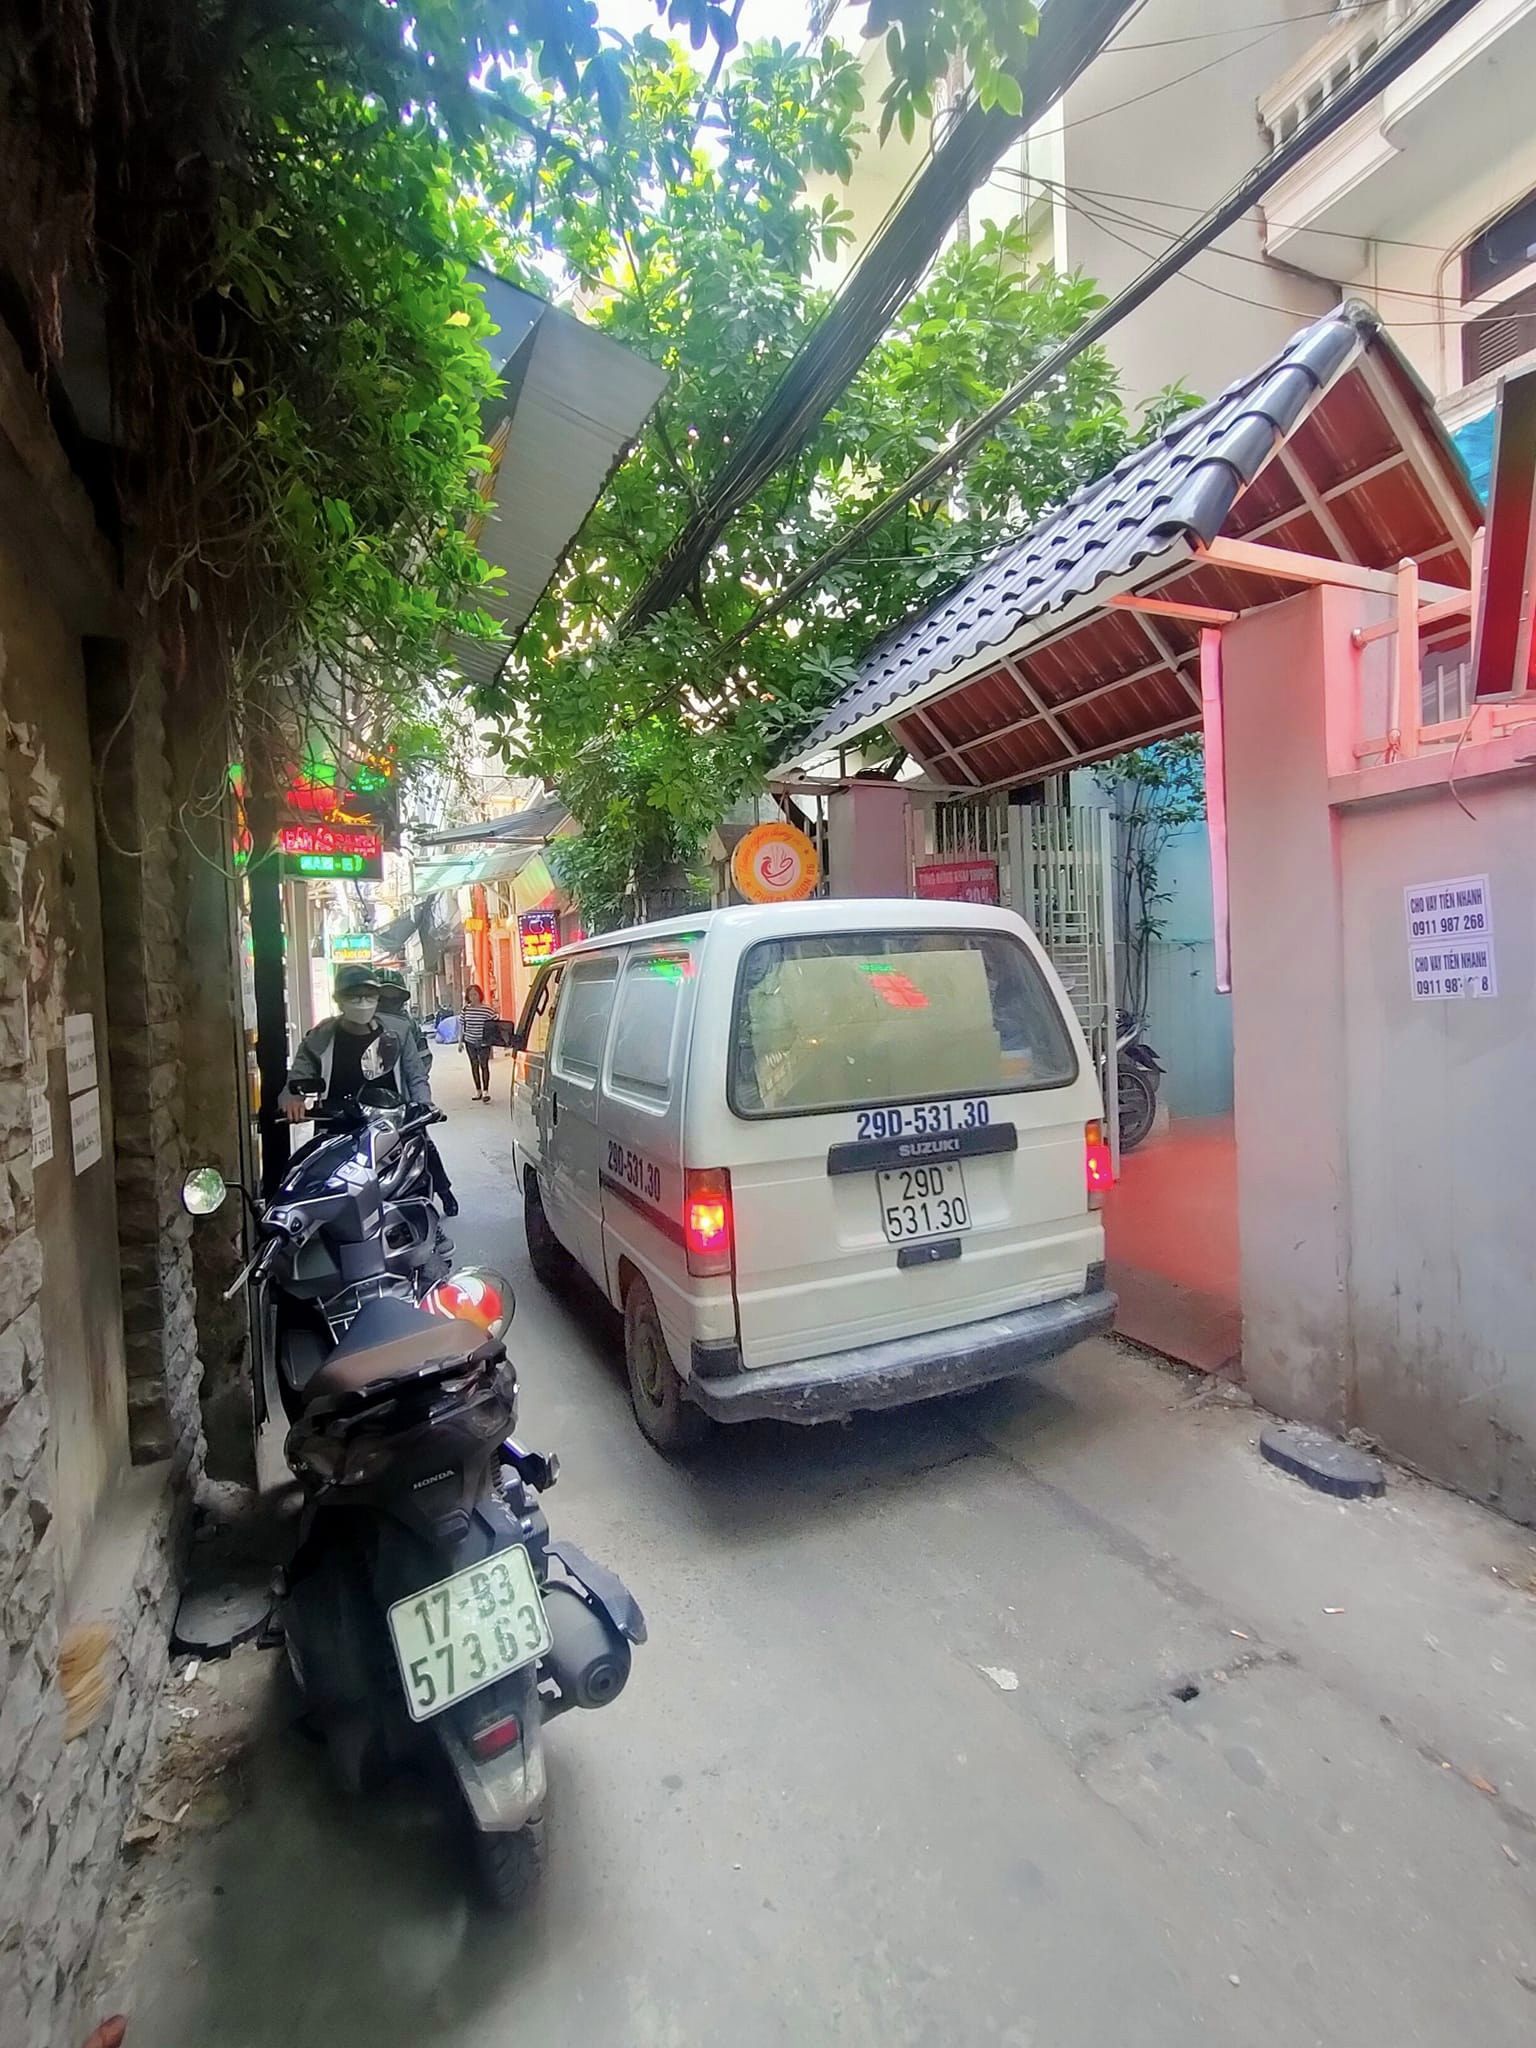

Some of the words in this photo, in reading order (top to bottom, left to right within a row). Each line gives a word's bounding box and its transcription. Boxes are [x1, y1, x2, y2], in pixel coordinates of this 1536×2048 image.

[1410, 897, 1424, 913] CHO
[1425, 895, 1437, 911] VAY
[1456, 888, 1482, 907] NHANH
[1412, 919, 1437, 936] 0911
[1440, 916, 1460, 933] 987
[1463, 913, 1485, 930] 268
[1415, 956, 1429, 972] CHO
[1429, 955, 1442, 971] VAY
[1460, 951, 1487, 969] NHANH
[1416, 980, 1441, 995] 0911
[1444, 977, 1462, 993] 98
[857, 1100, 989, 1141] 29D-531.30
[899, 1138, 960, 1157] SUZUKI
[608, 1140, 660, 1203] 29D-531.30
[900, 1166, 944, 1201] 29D
[886, 1197, 967, 1237] 531.30
[413, 1469, 455, 1490] HONDA
[410, 1604, 542, 1707] 573.63
